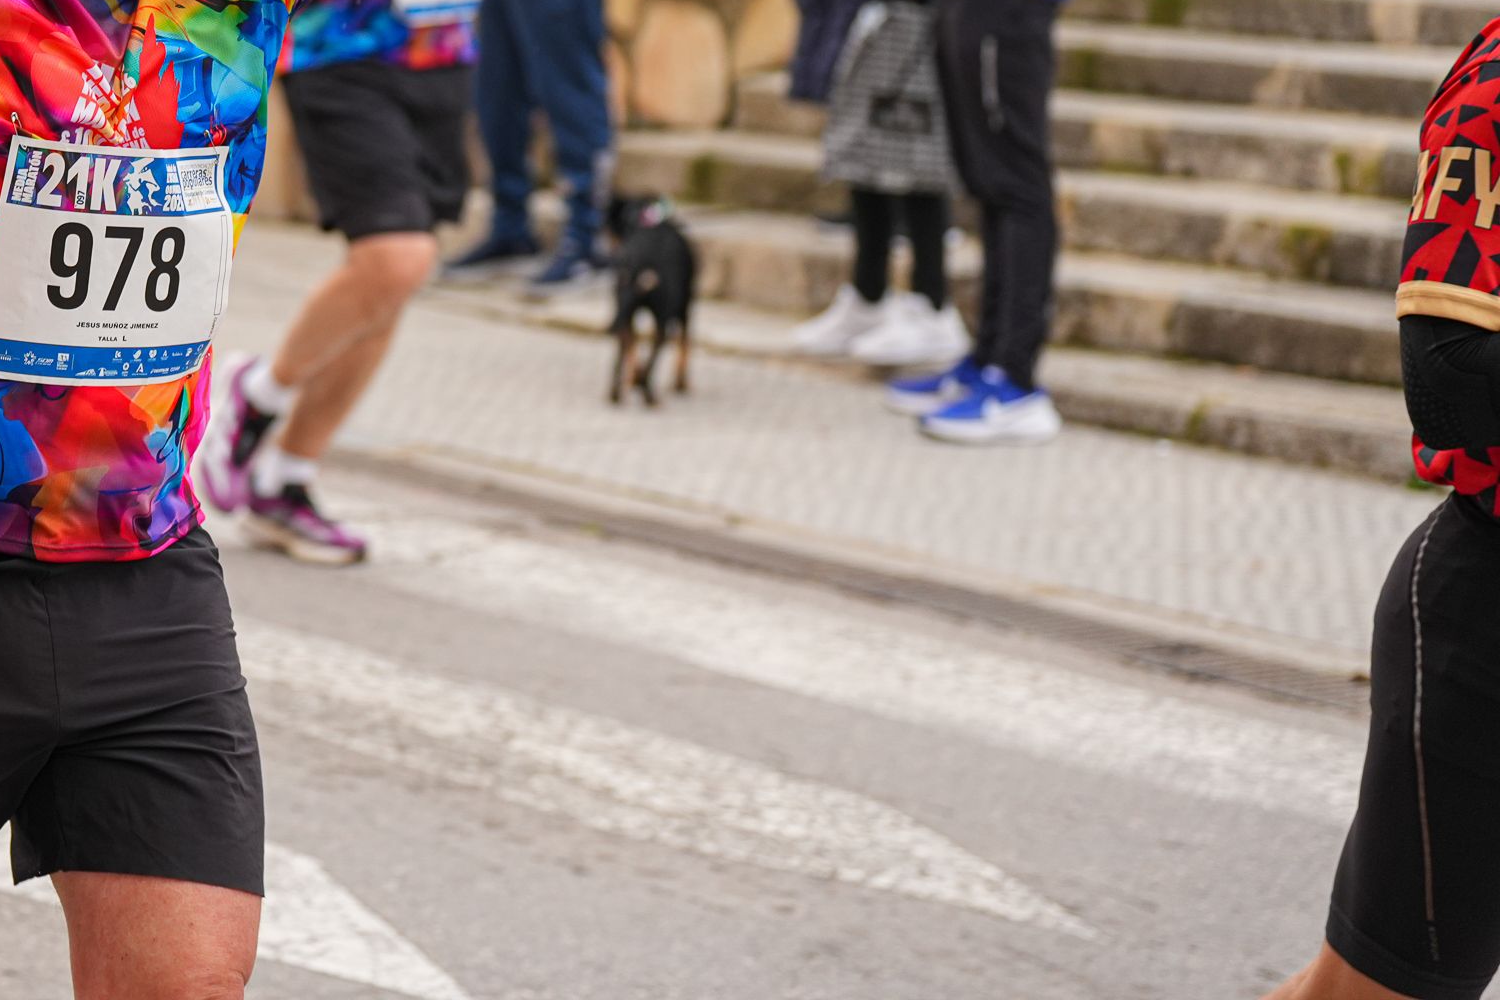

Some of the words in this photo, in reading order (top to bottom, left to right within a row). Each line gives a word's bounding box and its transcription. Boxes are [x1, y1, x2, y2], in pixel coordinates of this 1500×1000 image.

[11, 168, 28, 202] MEDIA
[21, 150, 43, 203] MARATÓN
[36, 152, 122, 211] 21K
[76, 190, 85, 205] 097
[47, 222, 186, 312] 978
